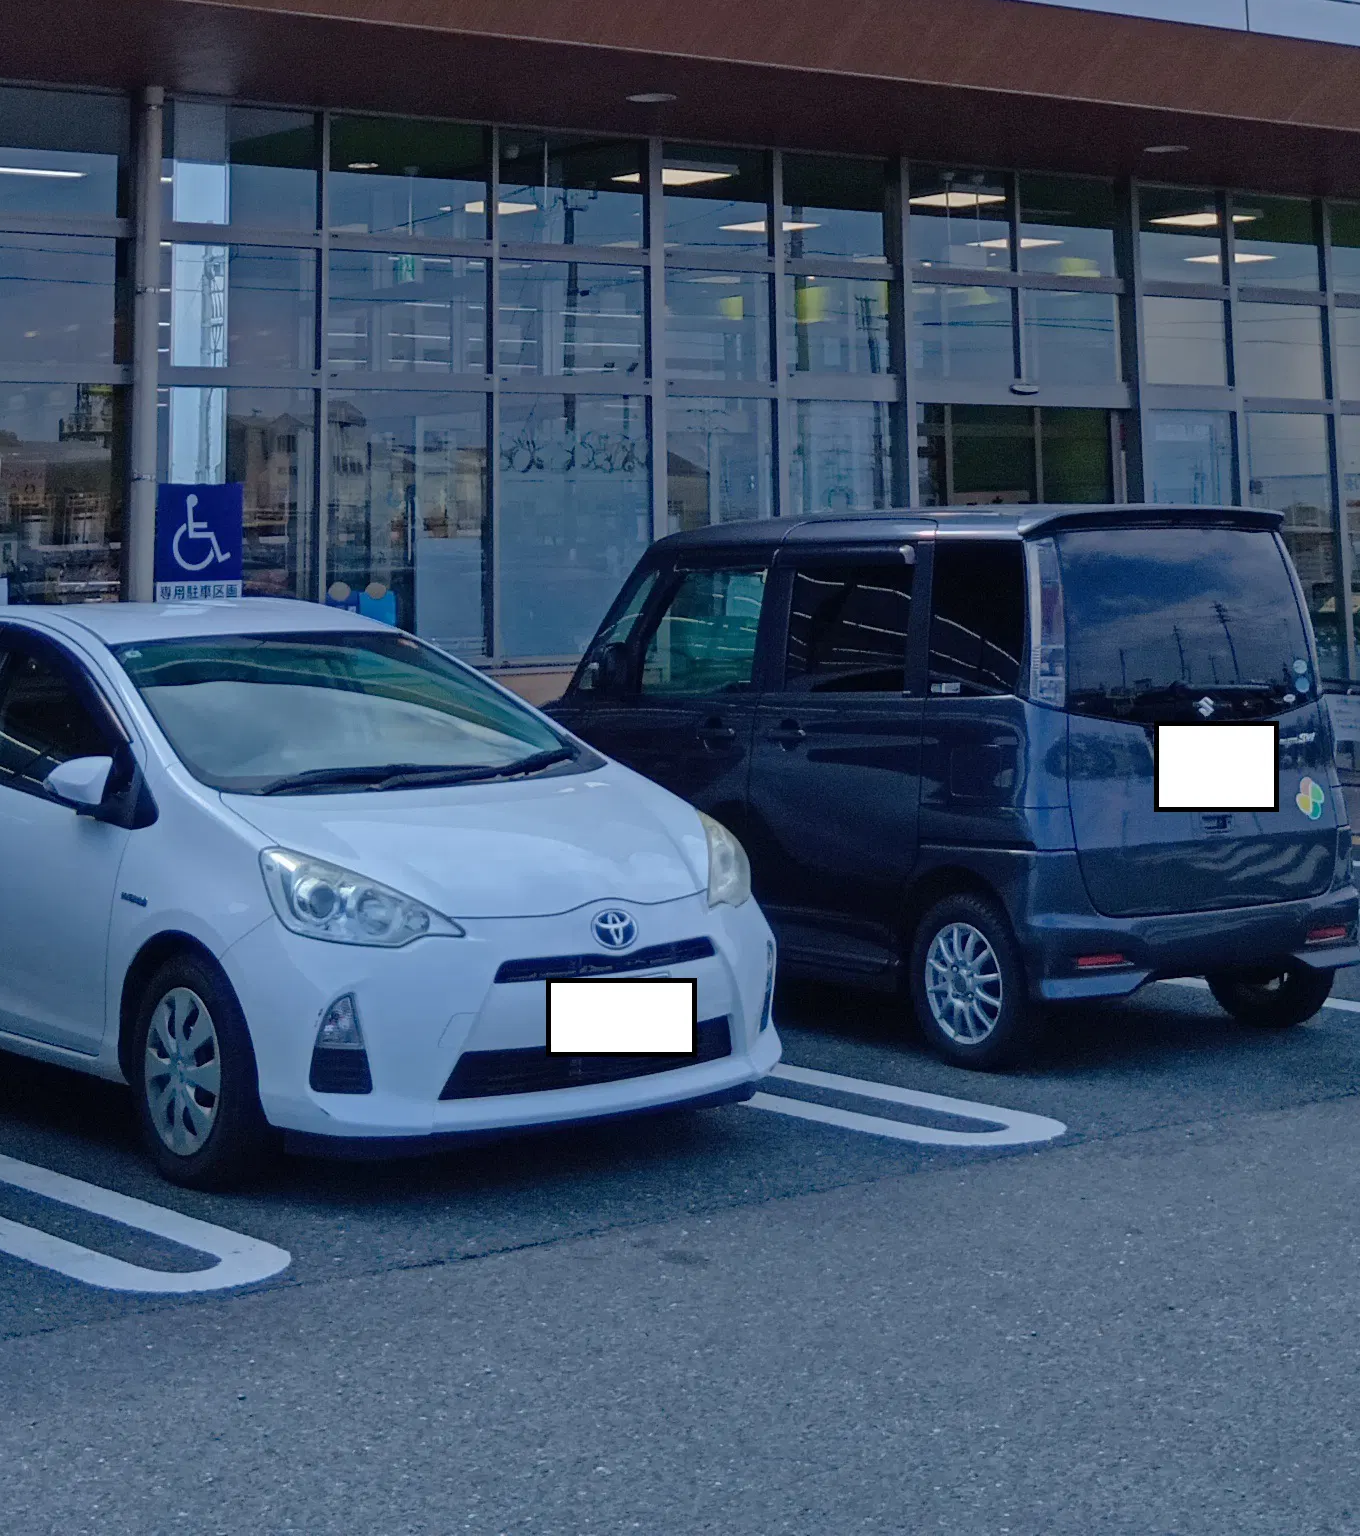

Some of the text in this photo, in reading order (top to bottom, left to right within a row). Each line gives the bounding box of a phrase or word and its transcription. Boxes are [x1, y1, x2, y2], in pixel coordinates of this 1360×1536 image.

[160, 584, 237, 600] 専用駐車区画
